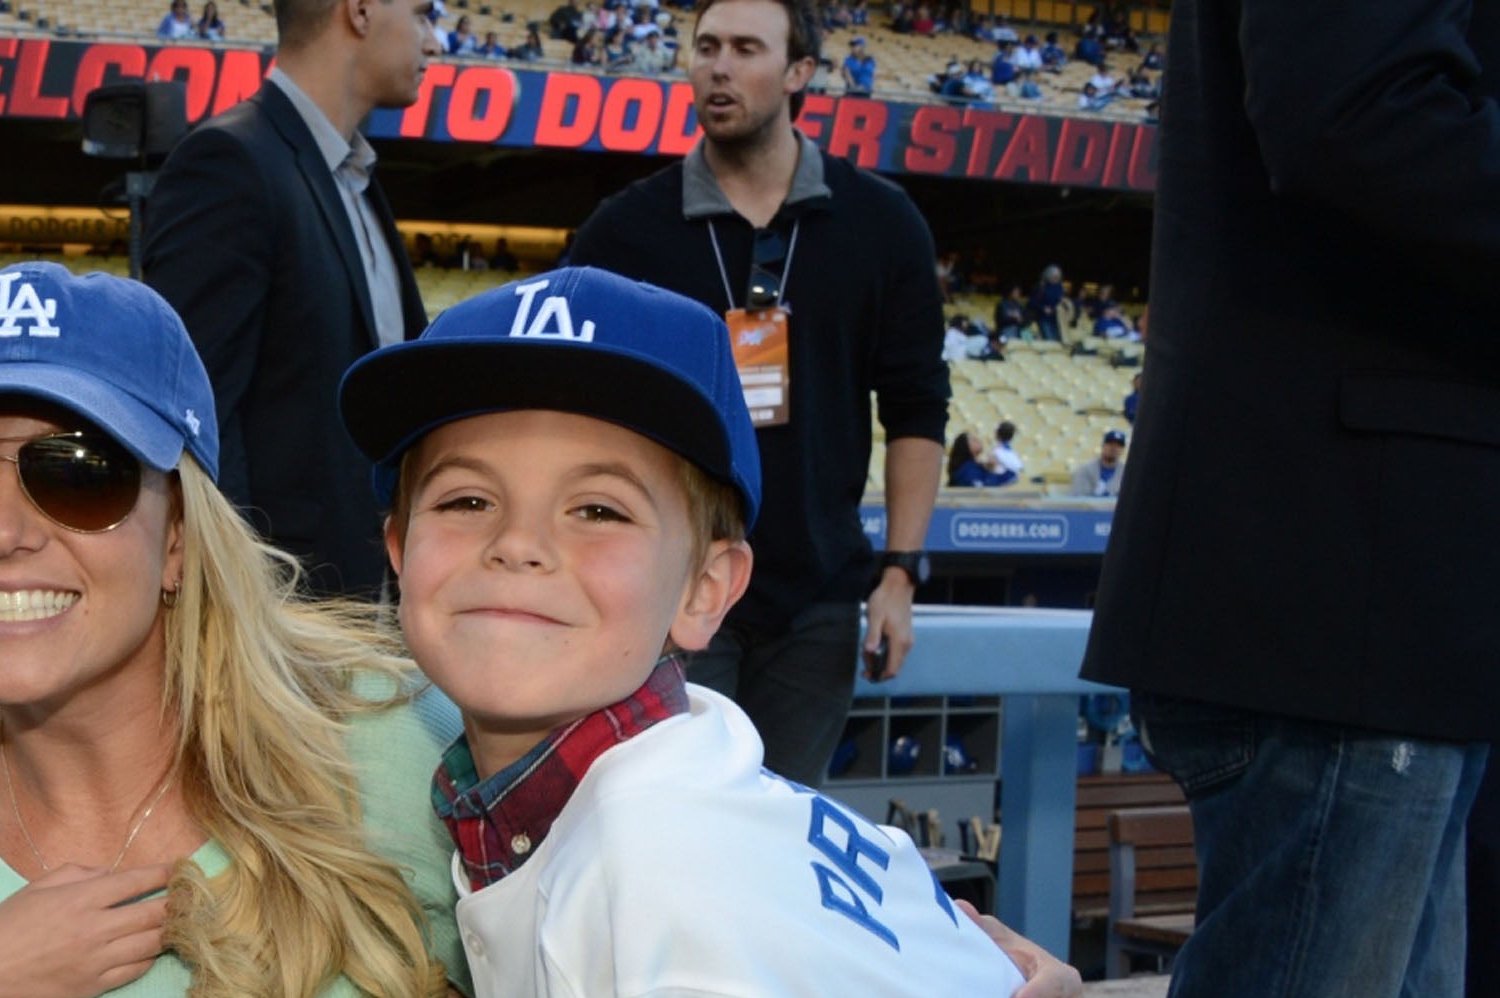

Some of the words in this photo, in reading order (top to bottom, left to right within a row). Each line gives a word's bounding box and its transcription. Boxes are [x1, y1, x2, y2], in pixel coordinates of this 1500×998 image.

[400, 63, 519, 143] TO
[533, 72, 890, 170] DODER
[904, 104, 1160, 191] STADIU
[957, 521, 1063, 540] DODGERS.COM
